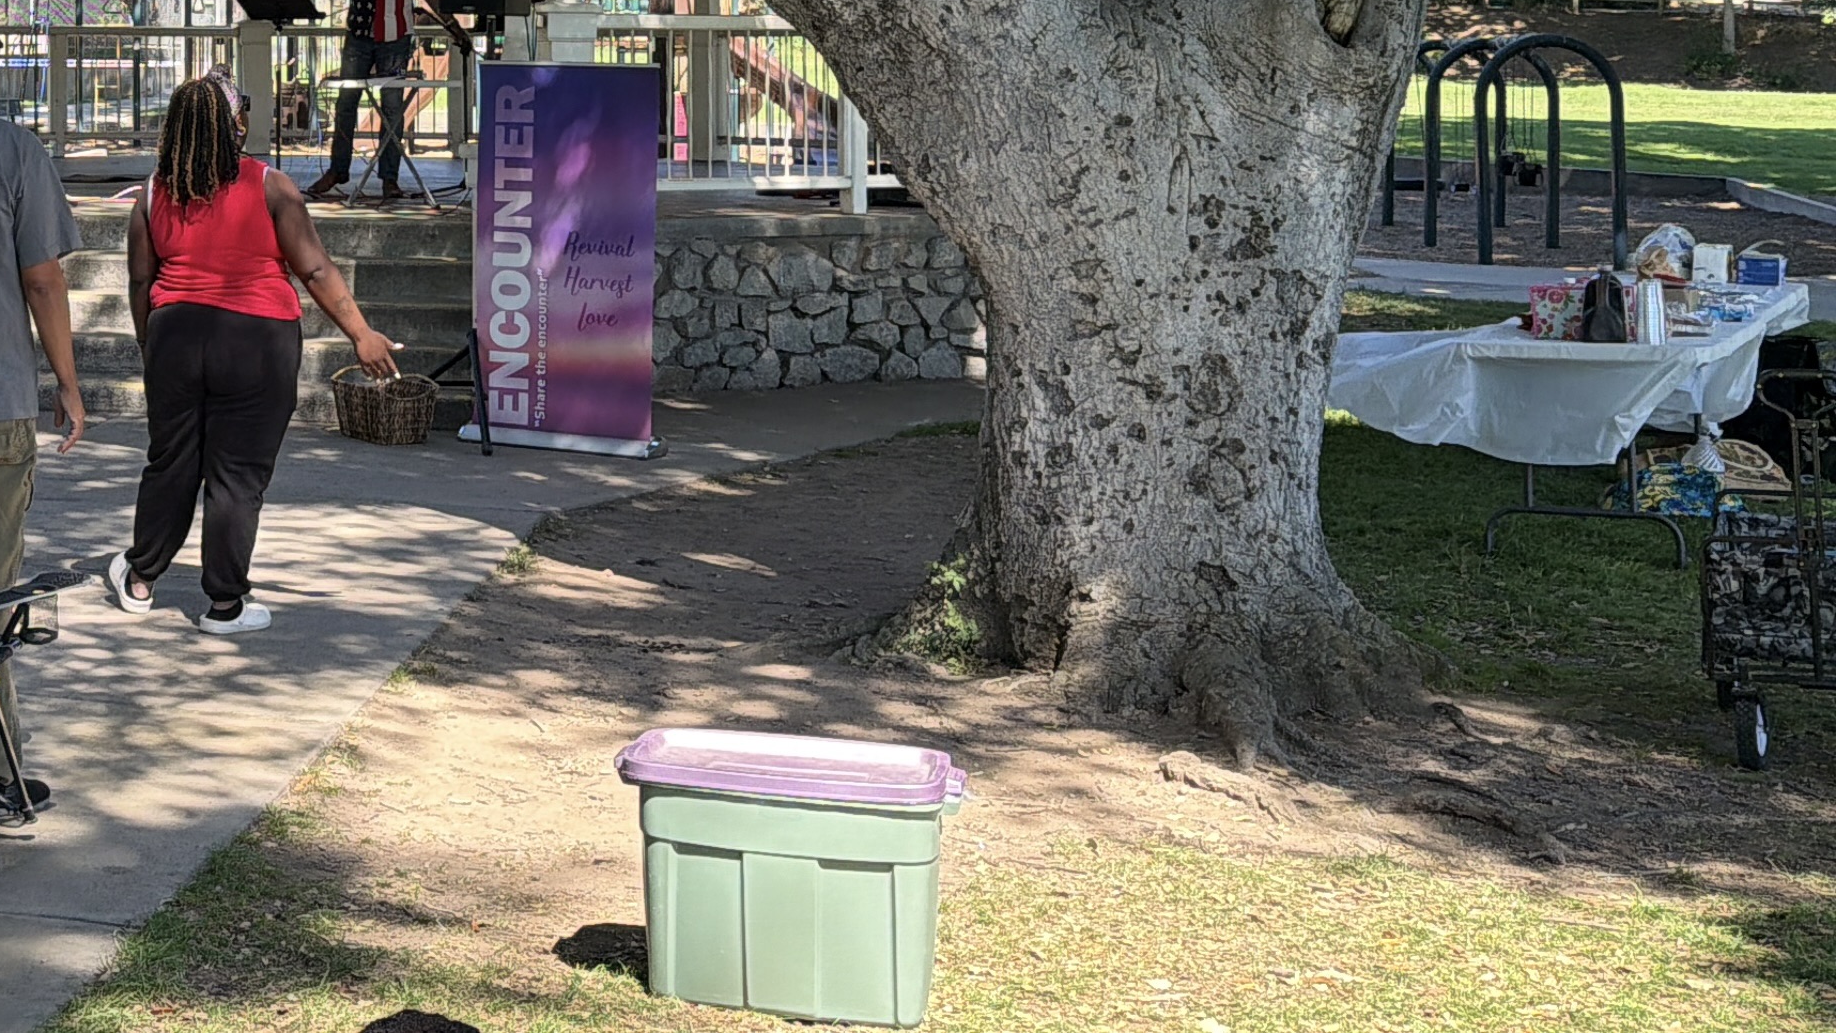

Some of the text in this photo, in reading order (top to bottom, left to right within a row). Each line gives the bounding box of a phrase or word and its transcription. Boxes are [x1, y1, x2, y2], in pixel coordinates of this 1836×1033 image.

[488, 85, 535, 426] ENCOUNTER
[564, 230, 635, 262] Revival
[564, 266, 634, 299] Harvest
[577, 302, 619, 332] Love
[535, 351, 546, 376] the
